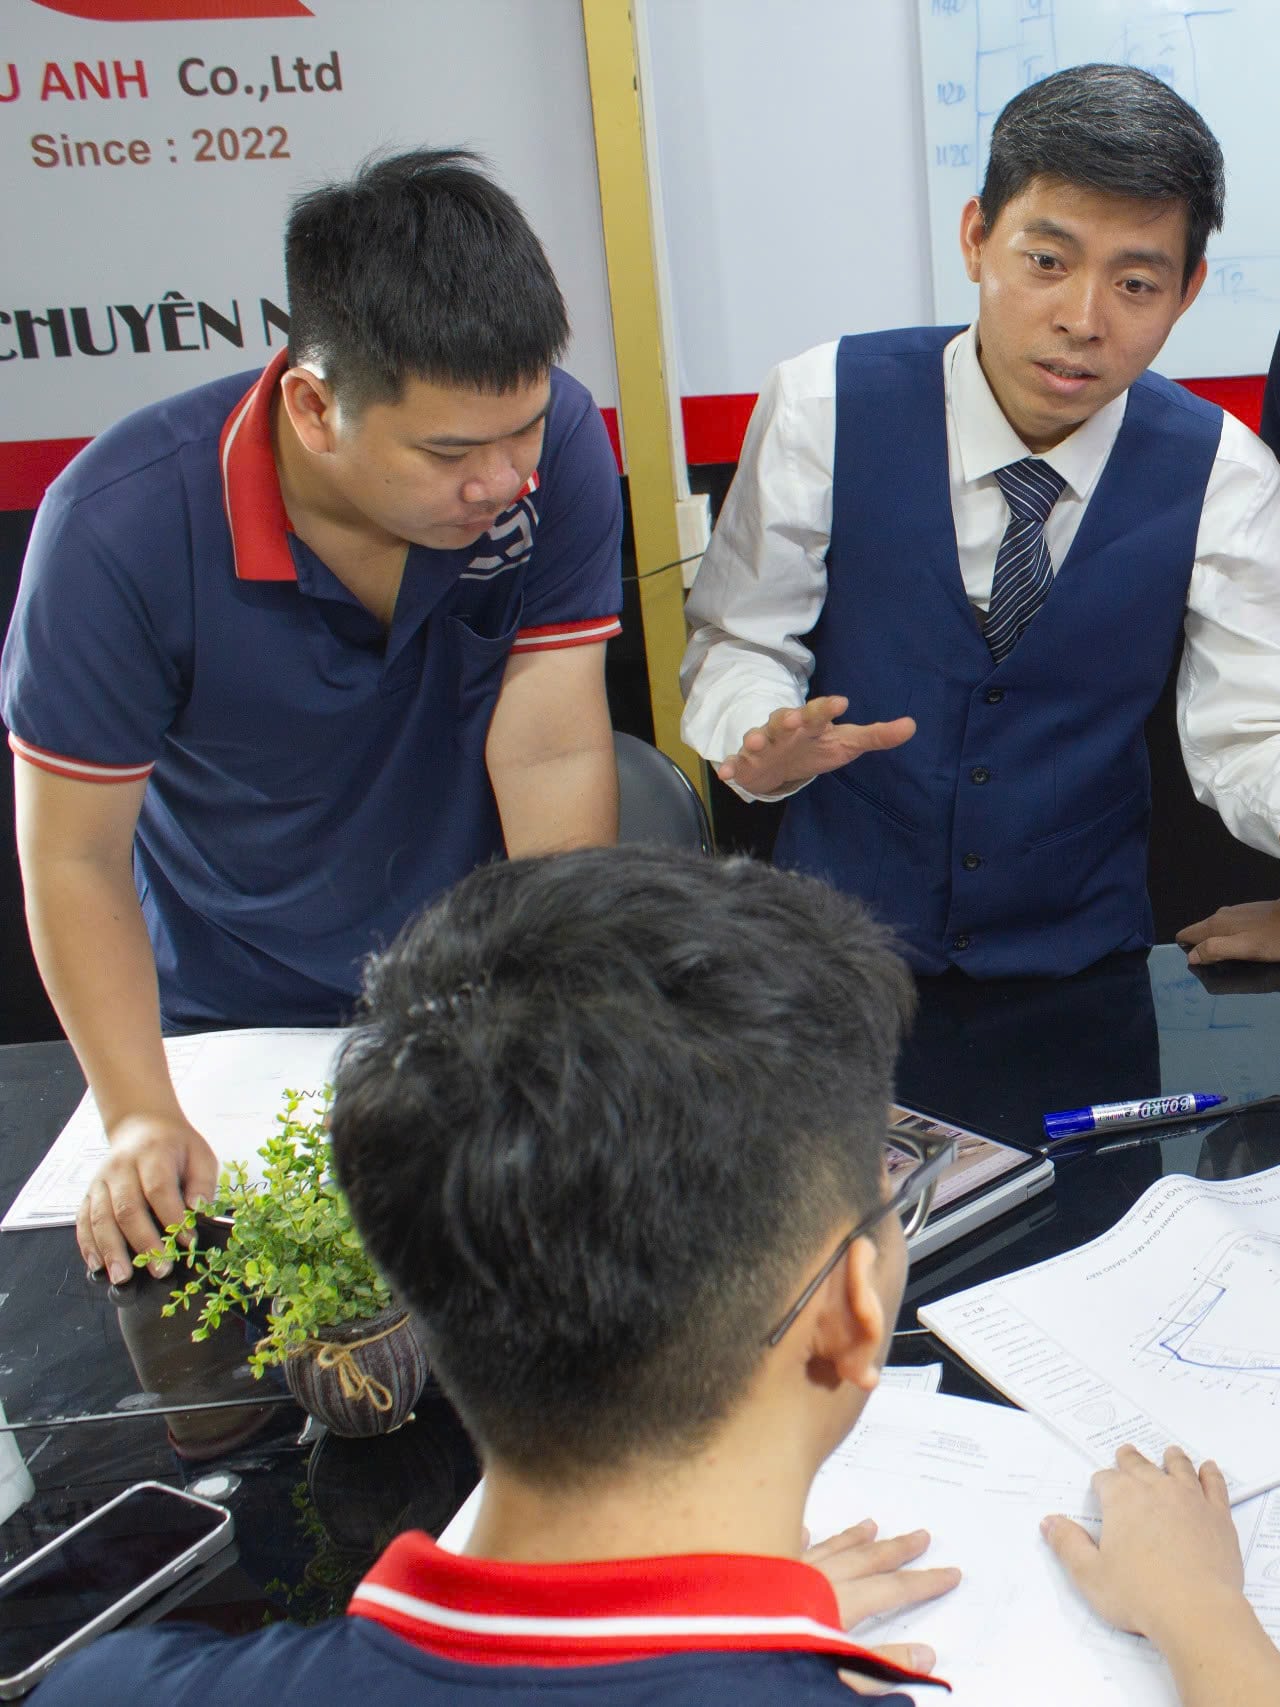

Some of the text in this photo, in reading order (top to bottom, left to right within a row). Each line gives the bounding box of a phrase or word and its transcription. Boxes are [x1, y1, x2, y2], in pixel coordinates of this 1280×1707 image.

[41, 60, 149, 101] ANH
[178, 51, 343, 102] Co.,Ltd
[31, 133, 151, 168] Since
[192, 126, 291, 162] 2022
[1138, 1096, 1191, 1119] BOARD
